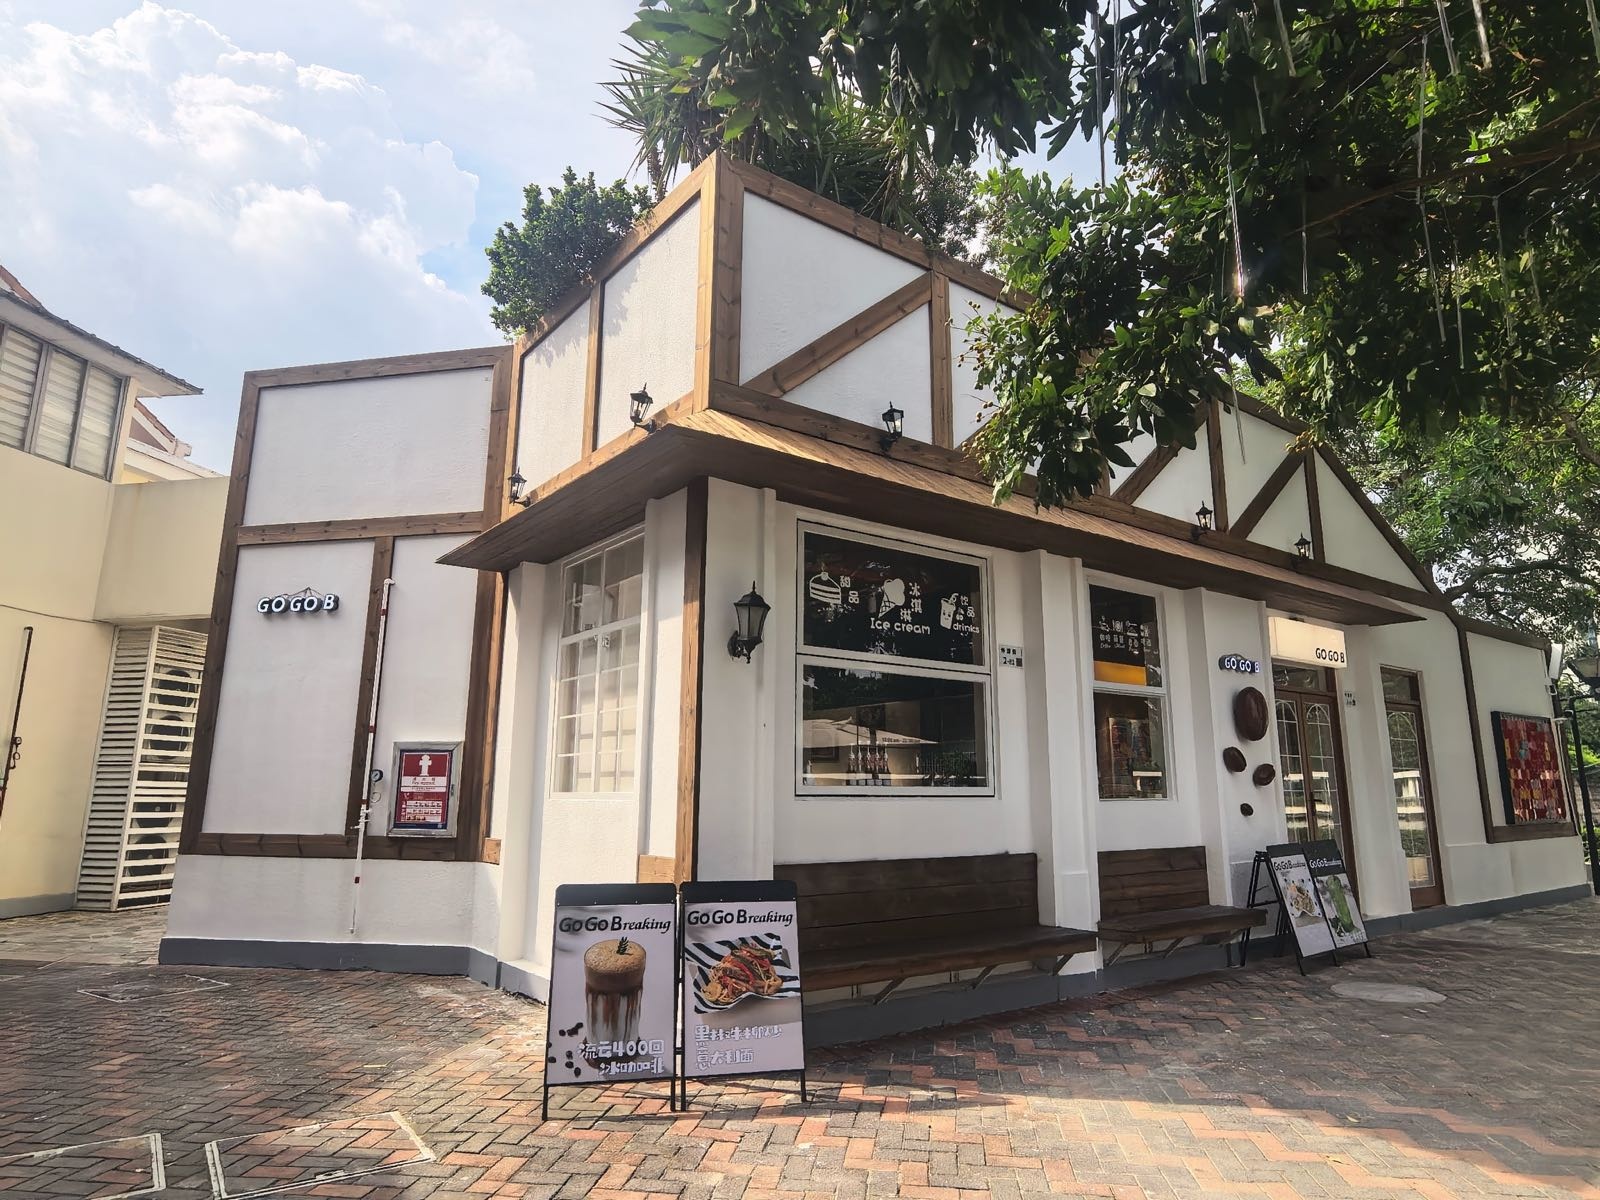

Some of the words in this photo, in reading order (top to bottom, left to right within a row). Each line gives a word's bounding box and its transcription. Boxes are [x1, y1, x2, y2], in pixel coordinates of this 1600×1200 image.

[870, 617, 891, 630] Ice
[893, 622, 931, 635] cream
[952, 622, 980, 634] drinks
